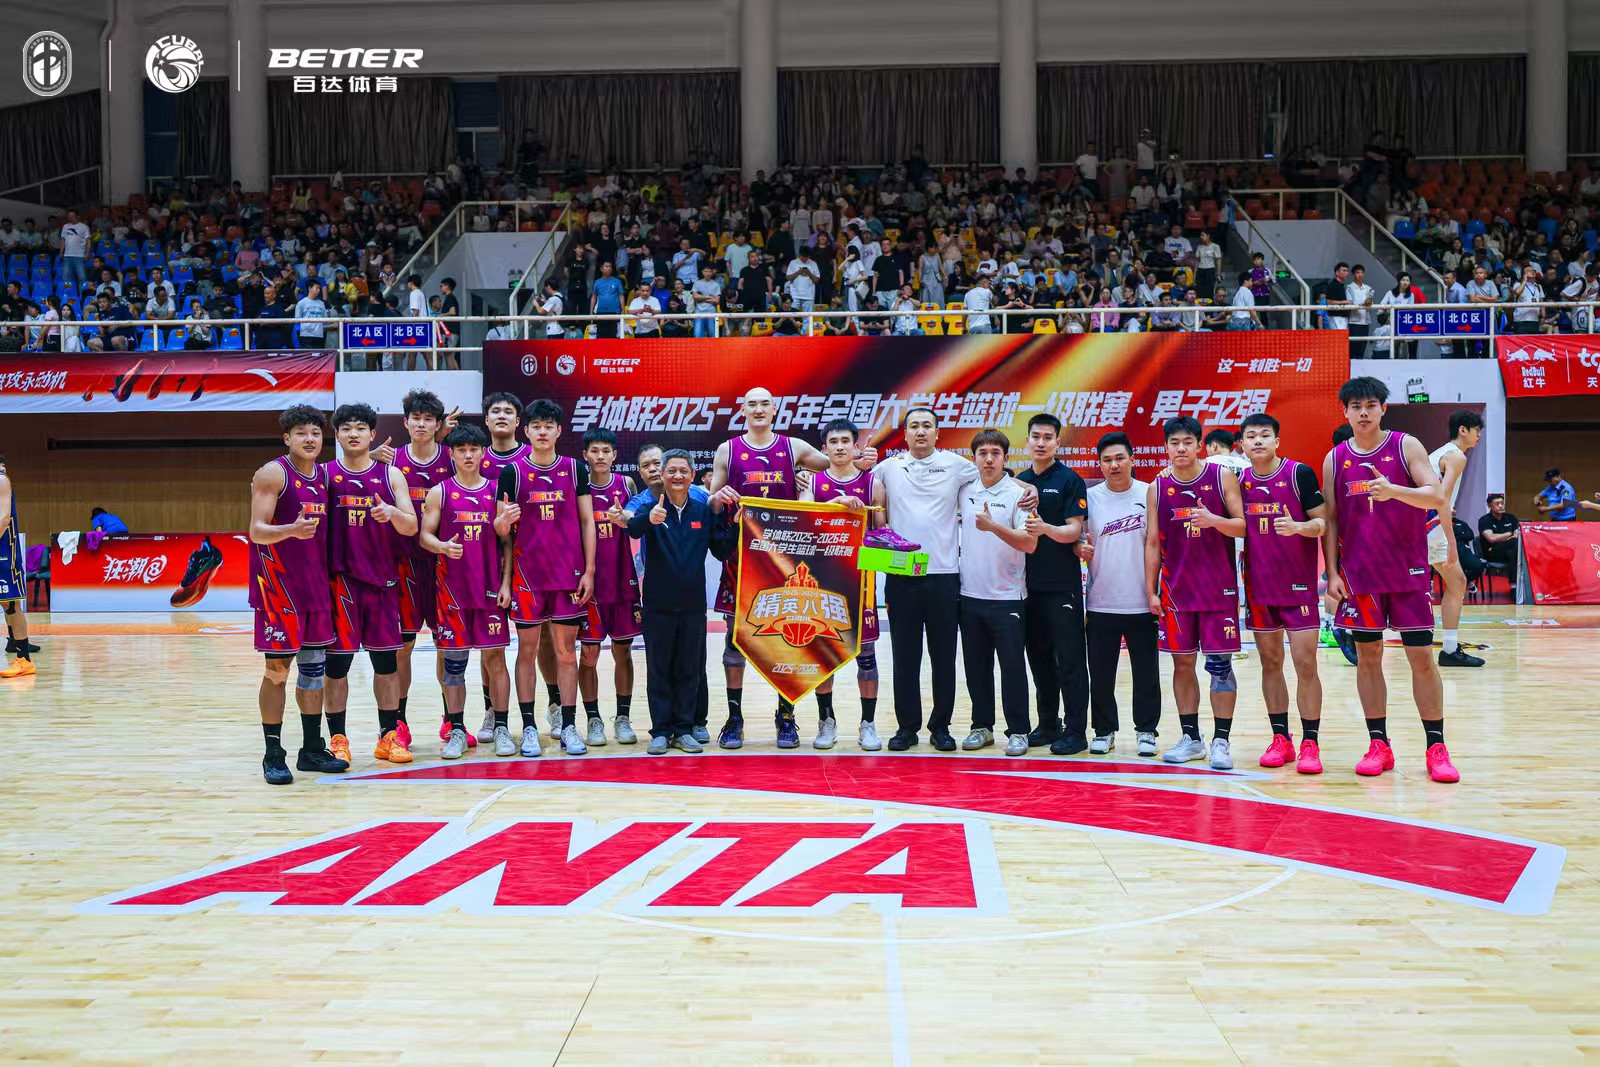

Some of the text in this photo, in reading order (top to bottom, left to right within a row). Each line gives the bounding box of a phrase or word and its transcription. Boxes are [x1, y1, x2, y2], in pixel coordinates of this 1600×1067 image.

[592, 358, 641, 366] BETTER
[1216, 357, 1313, 373] 这一刻胜一切
[1523, 377, 1546, 388] 红牛
[539, 504, 555, 521] 15
[463, 525, 482, 542] 37
[762, 528, 850, 544] 学体联2025-2026年
[749, 538, 854, 557] 全国大学生篮球一级联赛
[753, 592, 849, 624] 精英八强
[106, 820, 980, 909] ANTA
